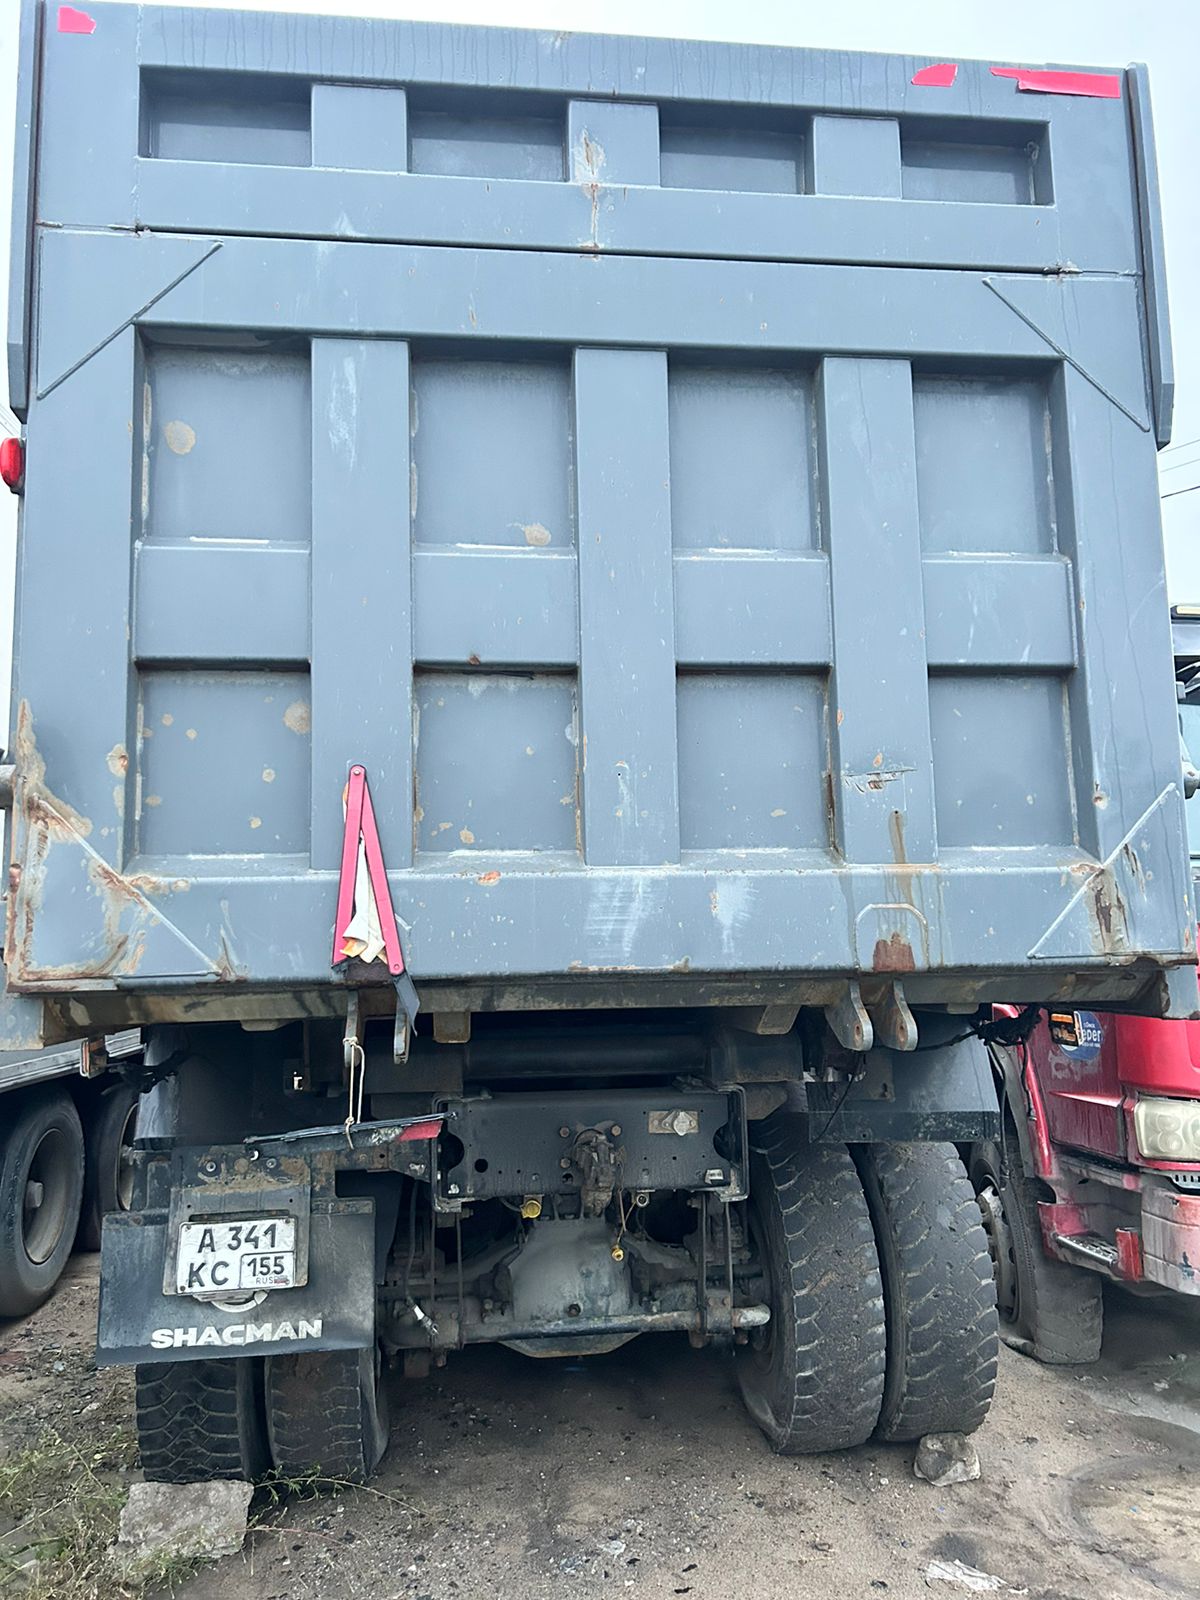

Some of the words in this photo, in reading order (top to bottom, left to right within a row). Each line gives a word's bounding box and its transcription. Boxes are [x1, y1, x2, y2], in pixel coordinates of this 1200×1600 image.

[227, 1223, 277, 1251] 341
[247, 1255, 285, 1277] 155
[255, 1276, 274, 1285] RUS
[151, 1319, 323, 1349] SHACMAN
